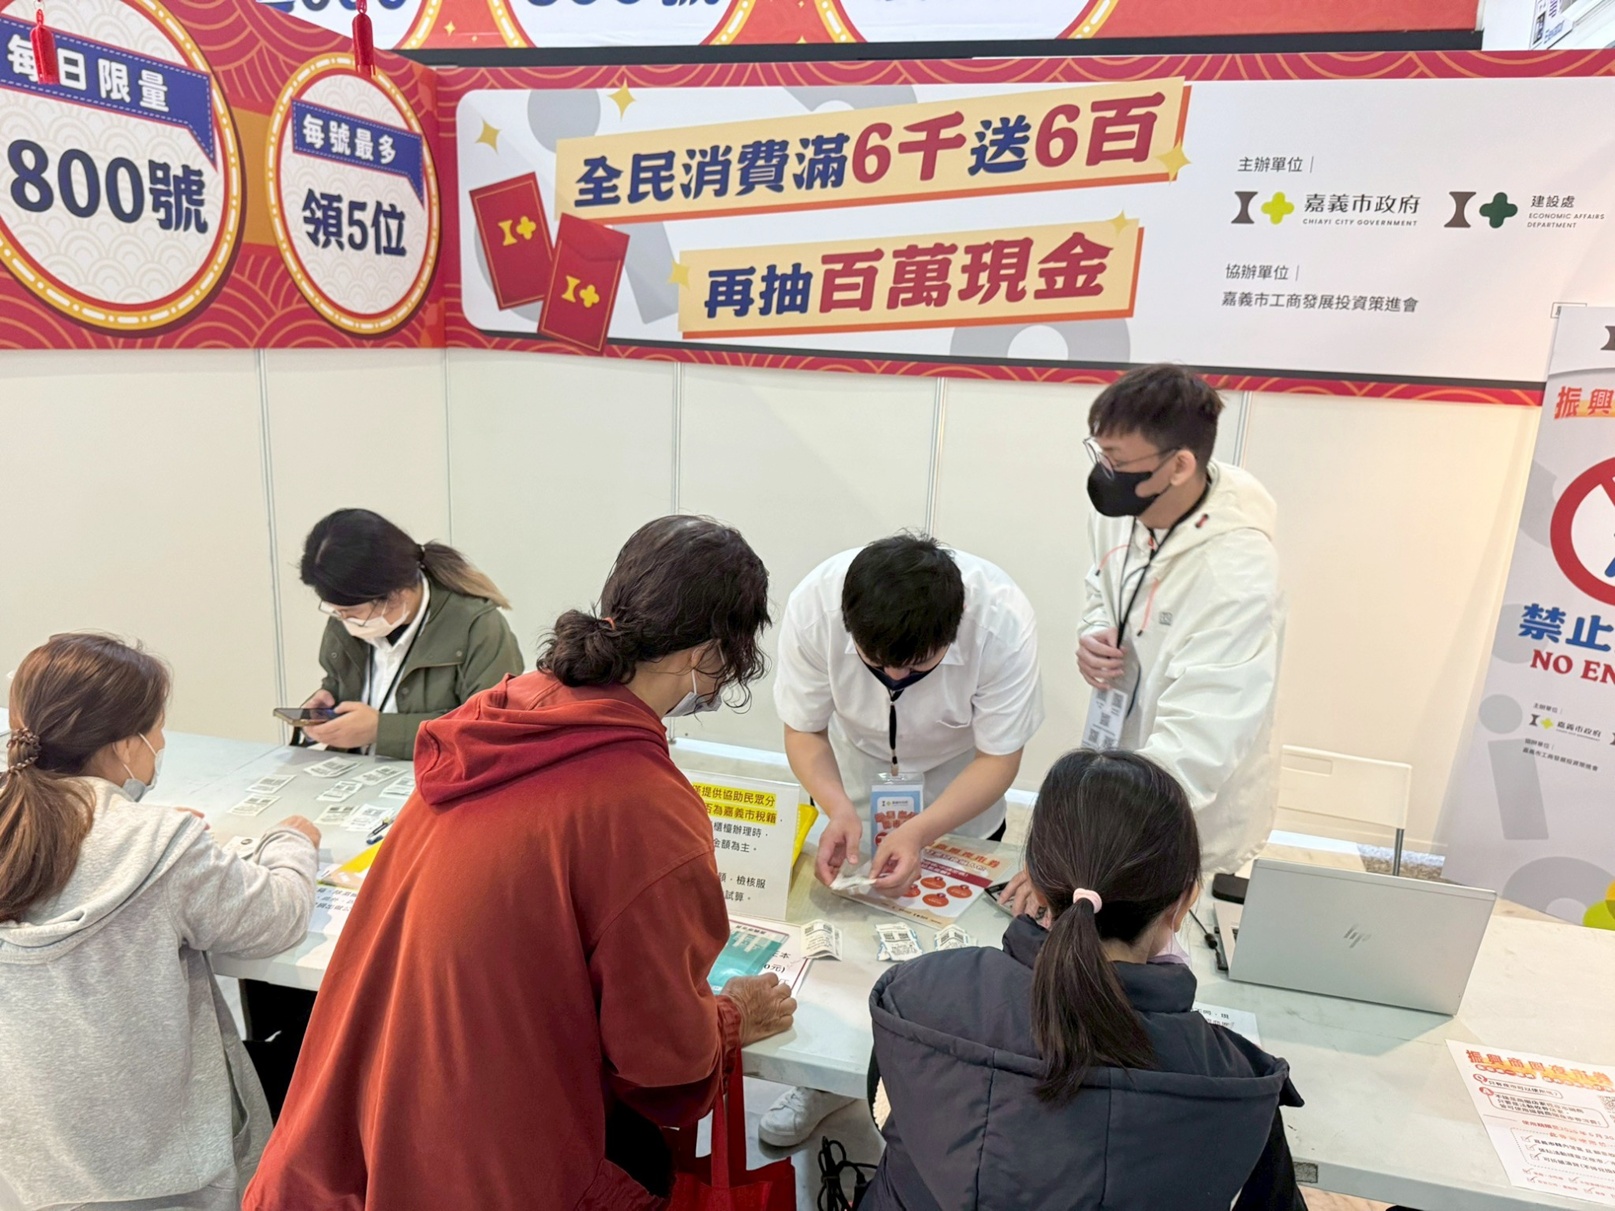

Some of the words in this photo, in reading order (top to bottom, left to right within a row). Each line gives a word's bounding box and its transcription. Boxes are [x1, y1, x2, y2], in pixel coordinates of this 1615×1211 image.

[7, 34, 169, 113] 每日限量
[302, 113, 397, 165] 每號最多
[574, 91, 1166, 207] 全民消費滿6千送6百
[1237, 156, 1303, 173] 主辦單位
[7, 139, 208, 234] 800號
[1304, 193, 1421, 214] 嘉義市政府
[1530, 195, 1575, 208] 建設處
[302, 188, 407, 257] 領5位
[704, 232, 1113, 319] 再抽百萬現金
[1225, 263, 1289, 280] 協辦單位
[1221, 291, 1419, 313] 嘉義市工商發展投資策進會
[1554, 386, 1614, 419] 振興
[1518, 603, 1614, 652] 禁止
[1530, 649, 1573, 675] NO
